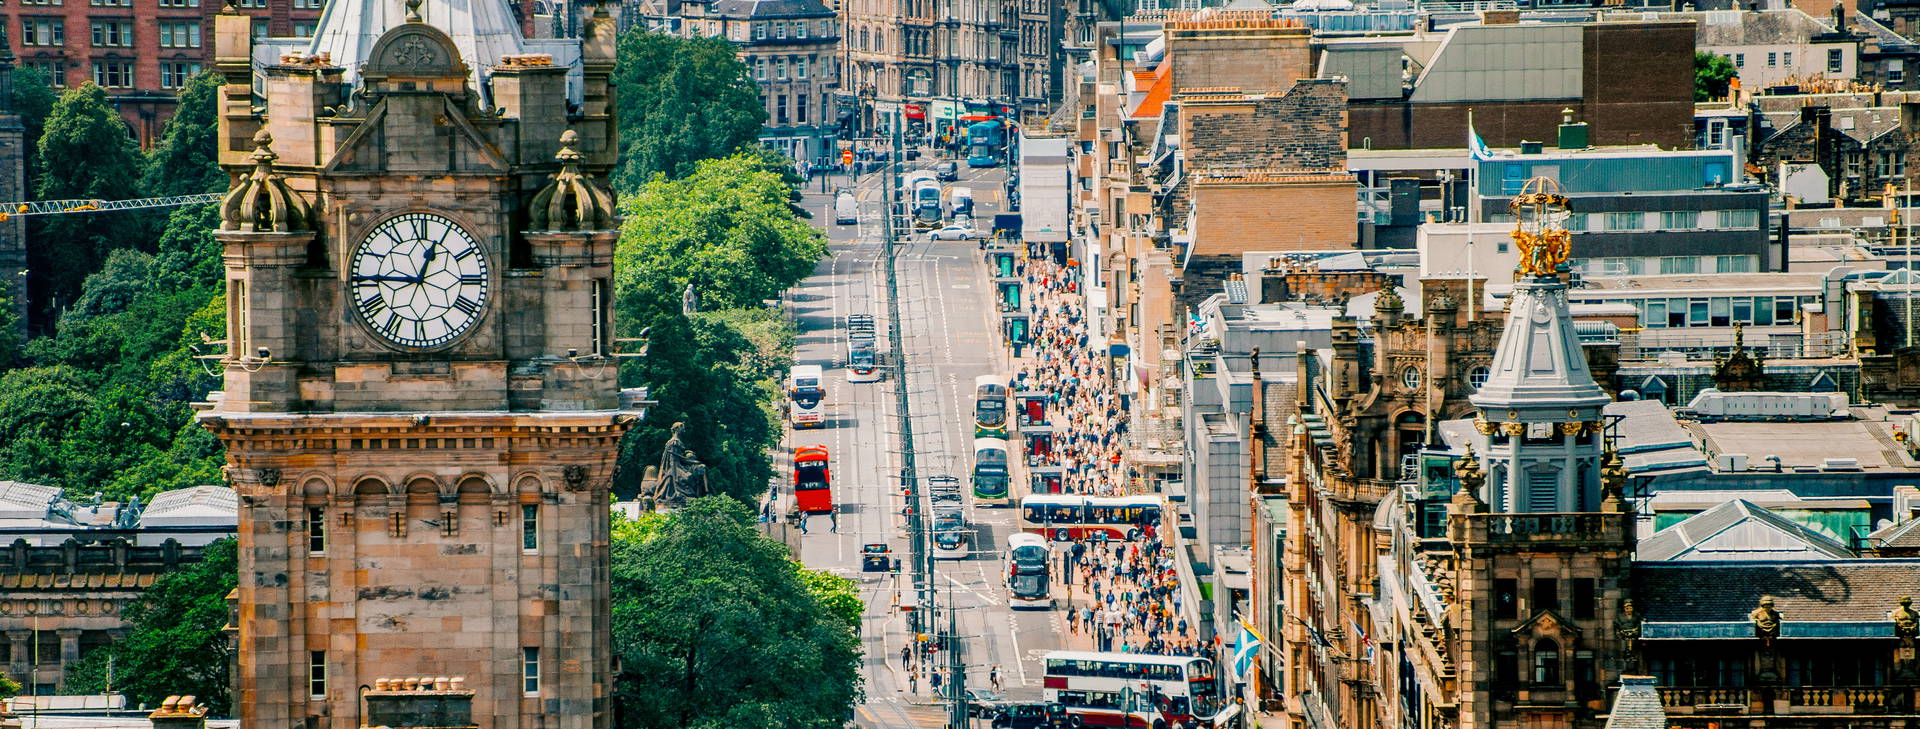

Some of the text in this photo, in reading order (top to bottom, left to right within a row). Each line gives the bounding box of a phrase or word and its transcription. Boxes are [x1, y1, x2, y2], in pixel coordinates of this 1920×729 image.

[382, 225, 403, 245] XI
[410, 218, 428, 240] XII
[439, 225, 452, 245] I
[454, 247, 475, 262] II
[460, 274, 482, 285] III
[362, 292, 387, 319] VIII
[453, 295, 481, 316] IIII
[383, 312, 404, 338] VII
[414, 320, 427, 341] VI
[441, 315, 455, 332] V
